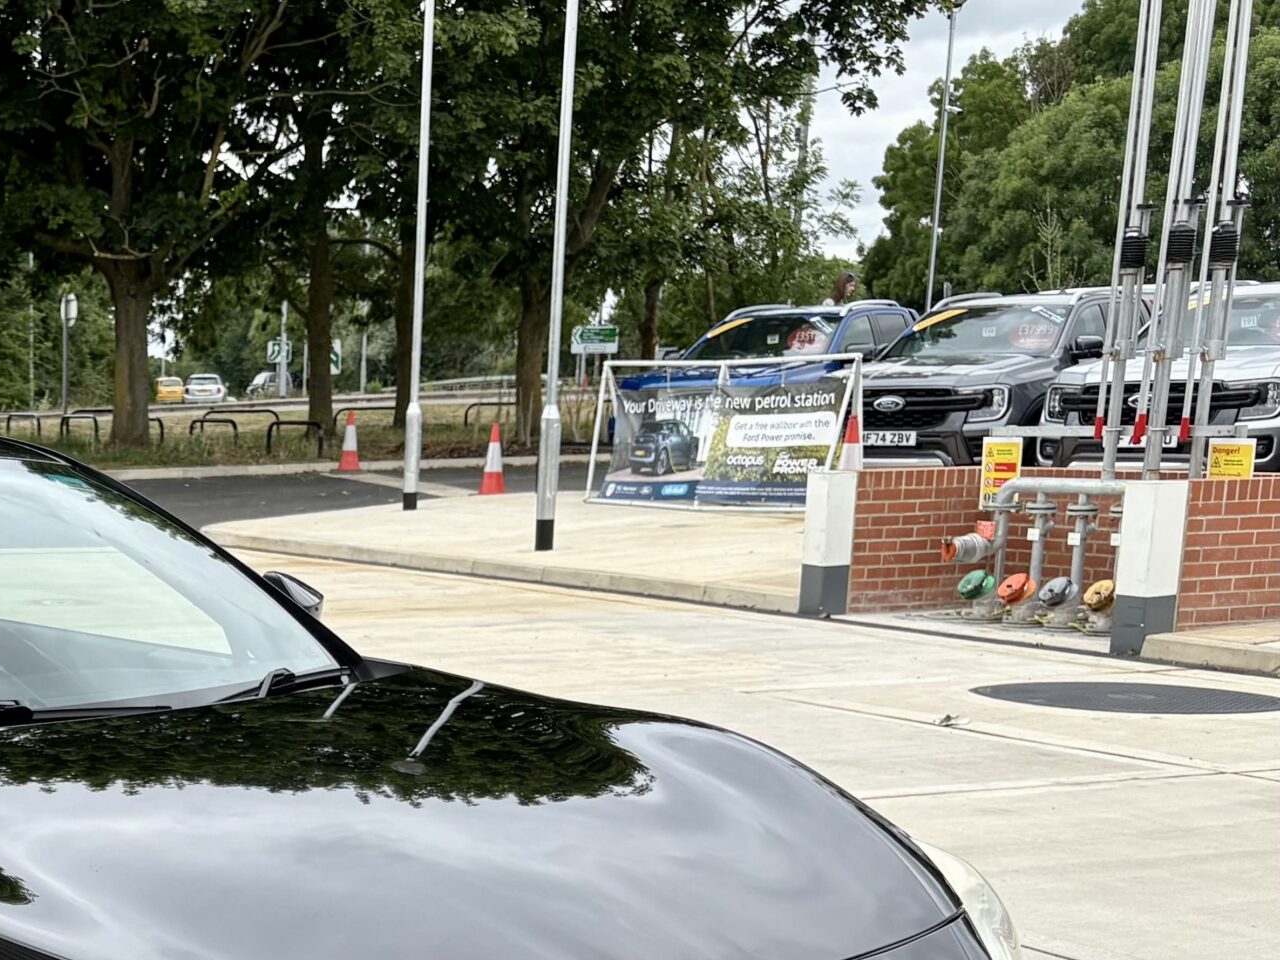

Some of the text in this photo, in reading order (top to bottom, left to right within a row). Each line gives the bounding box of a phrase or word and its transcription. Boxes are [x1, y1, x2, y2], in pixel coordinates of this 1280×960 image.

[623, 400, 646, 413] Your
[648, 397, 692, 413] Driveway
[694, 396, 701, 410] is
[725, 396, 751, 409] new
[755, 393, 791, 411] petrol
[794, 391, 835, 407] station
[734, 422, 746, 430] Get
[754, 421, 769, 430] free
[770, 421, 798, 430] wallbox
[814, 418, 830, 428] the
[742, 433, 759, 442] Ford
[761, 433, 783, 441] Power
[889, 433, 912, 444] ZBV
[1212, 446, 1241, 456] Danger!
[726, 455, 764, 467] octopus
